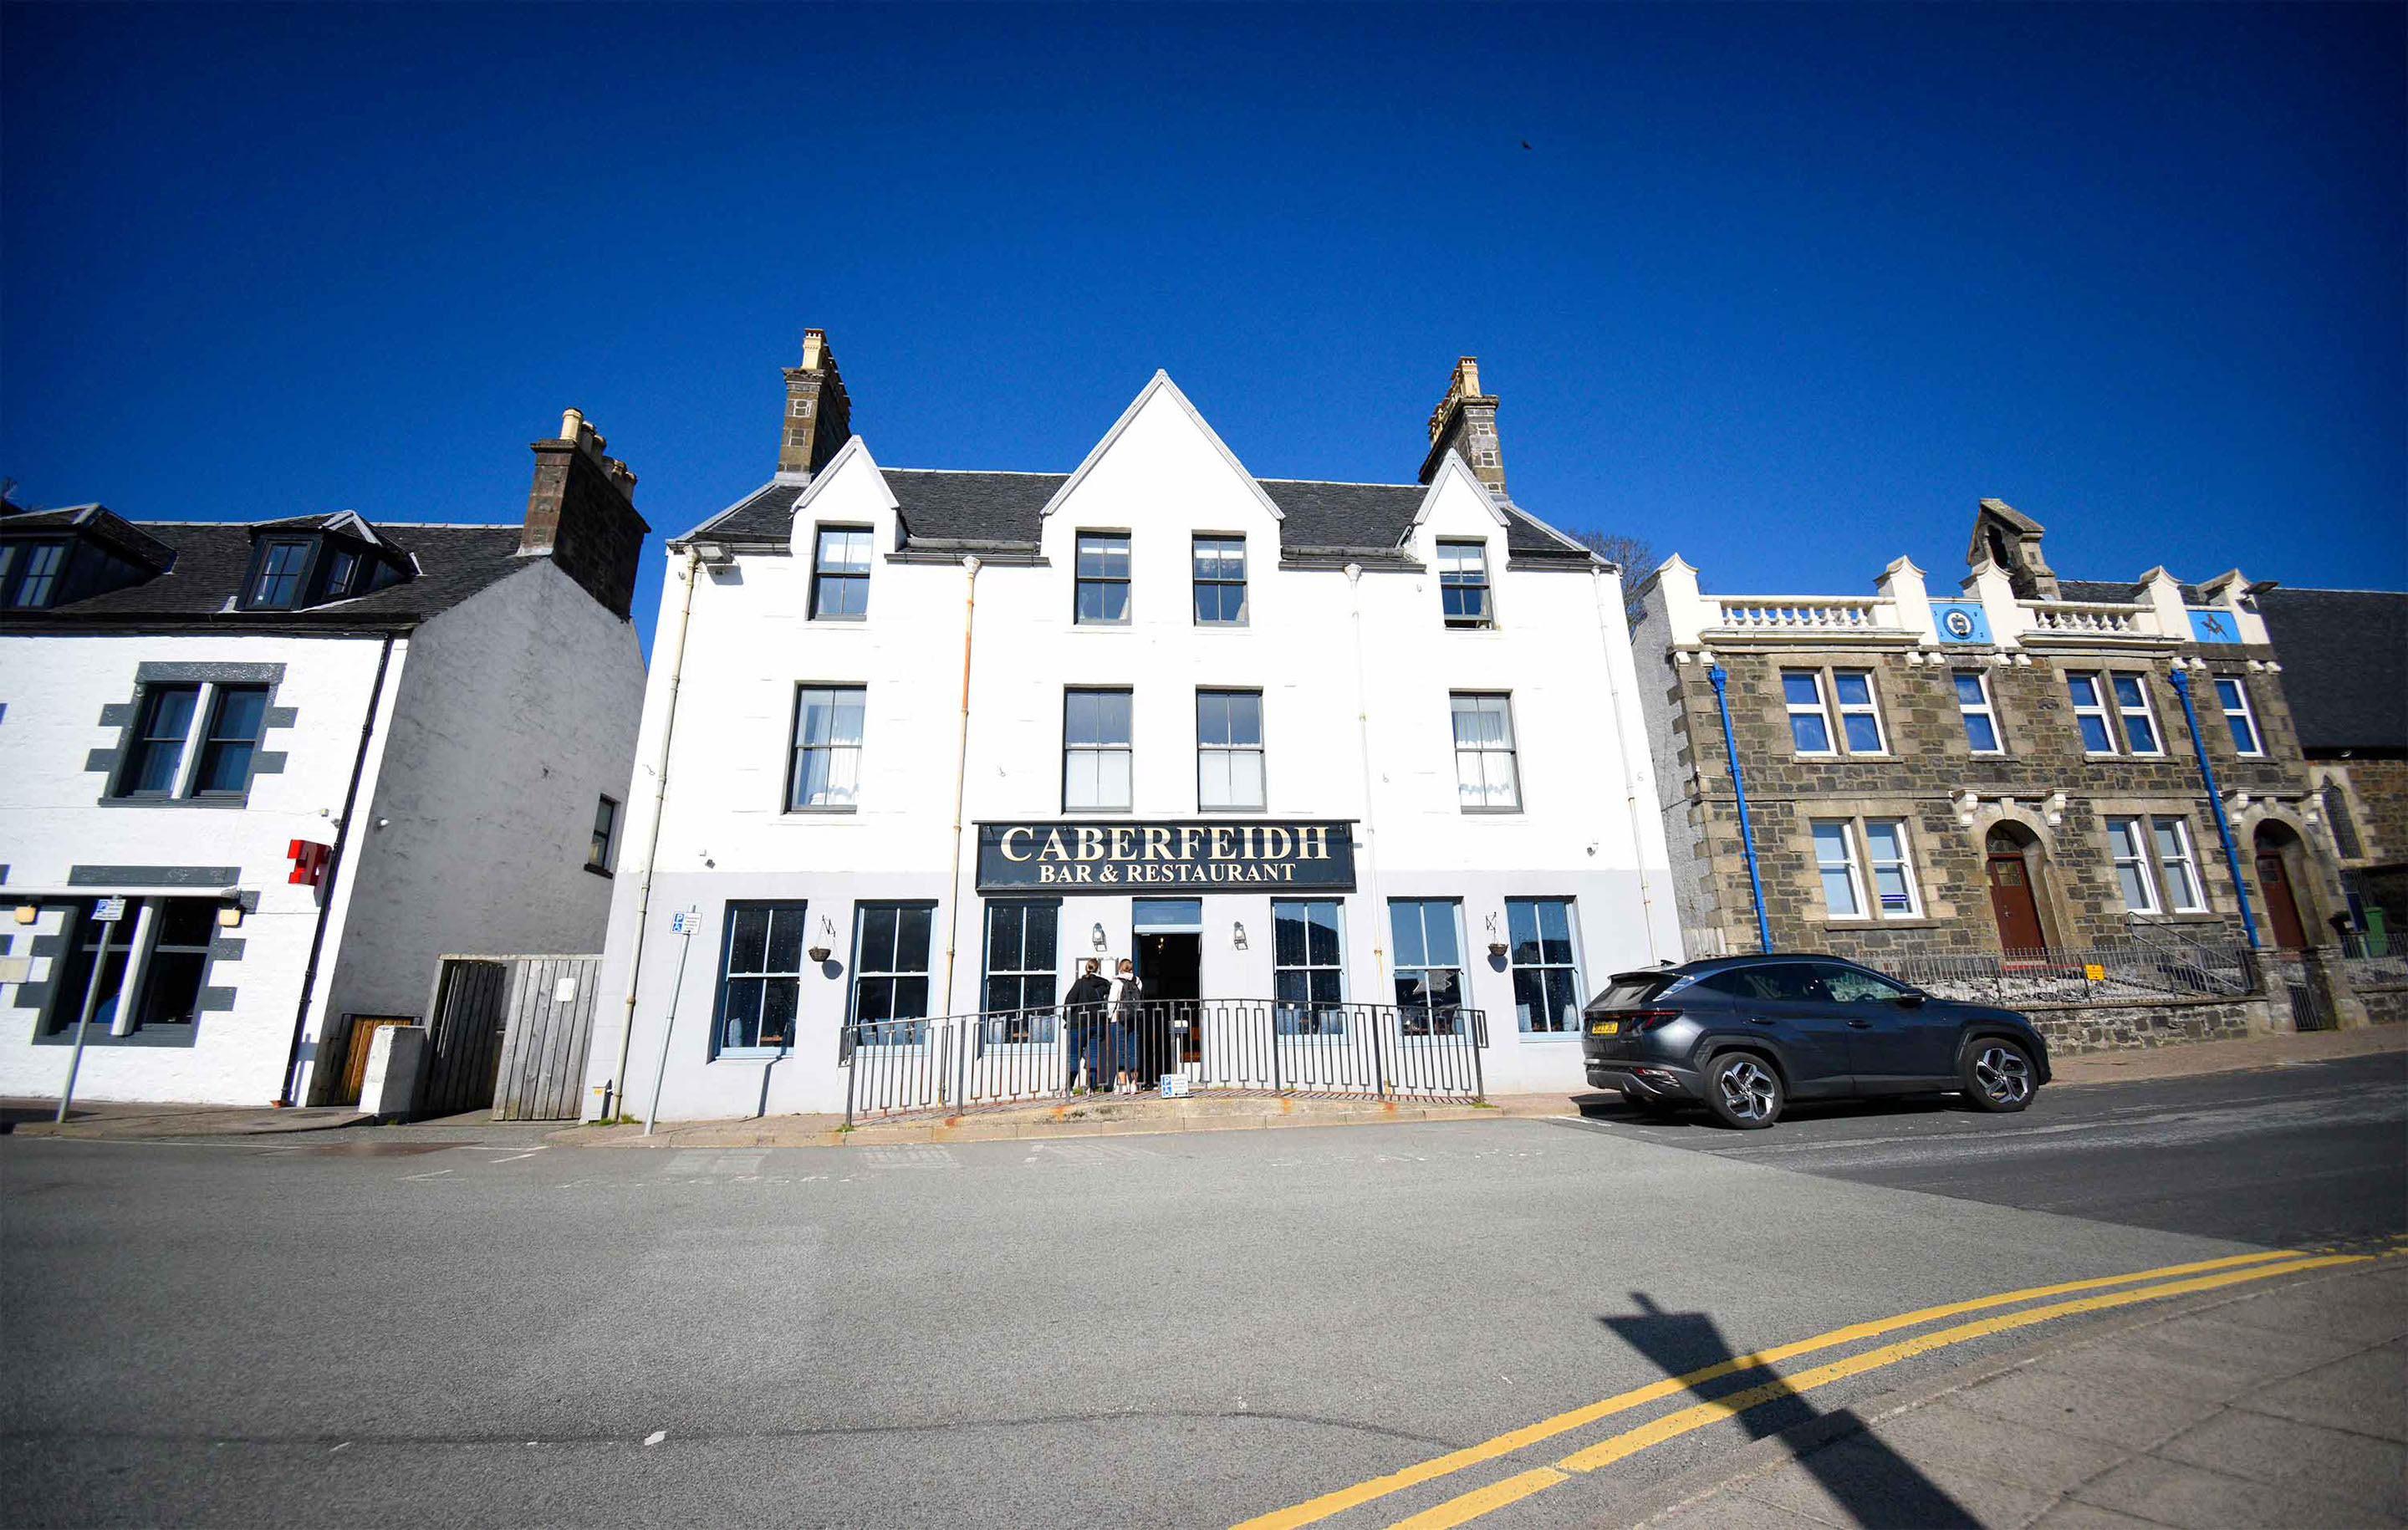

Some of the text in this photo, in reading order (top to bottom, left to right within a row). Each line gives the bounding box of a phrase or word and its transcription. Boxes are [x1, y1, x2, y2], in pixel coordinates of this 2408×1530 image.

[1000, 826, 1331, 861] CABERFEIDH
[1039, 864, 1296, 884] BAR & RESTAURANT
